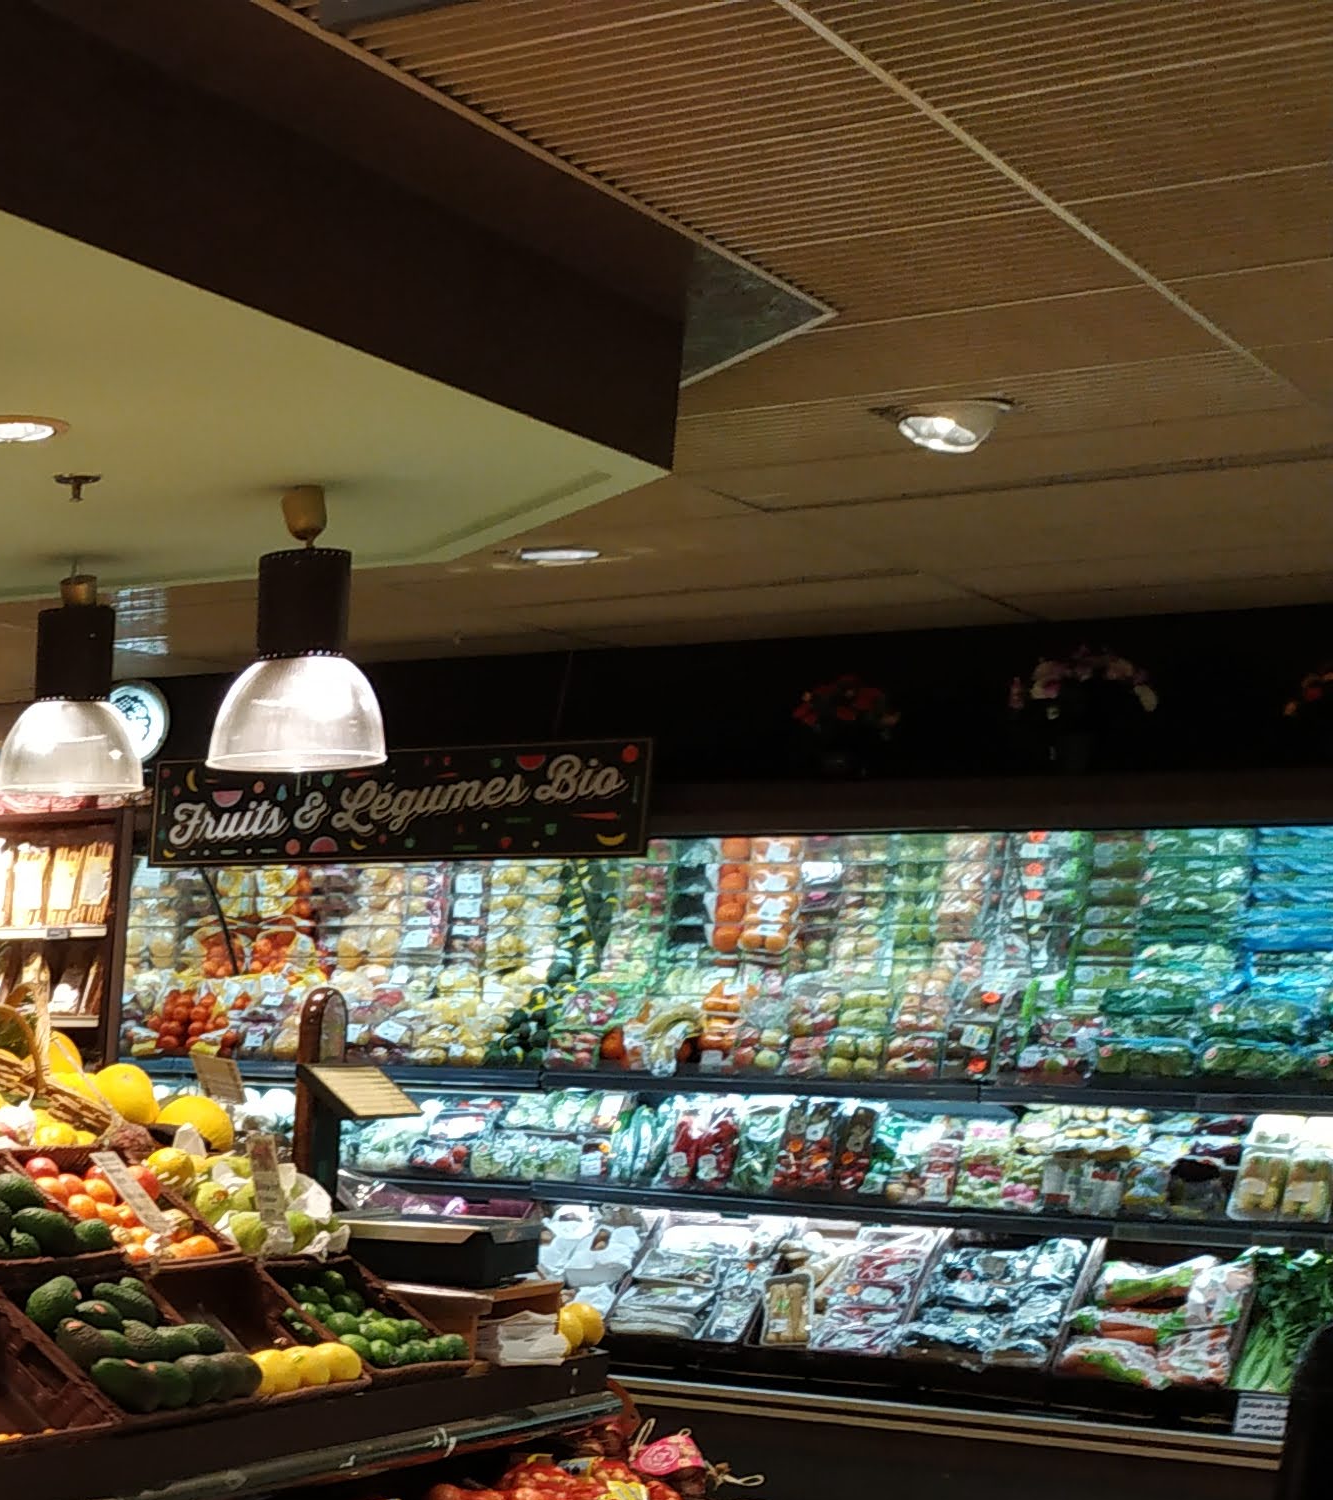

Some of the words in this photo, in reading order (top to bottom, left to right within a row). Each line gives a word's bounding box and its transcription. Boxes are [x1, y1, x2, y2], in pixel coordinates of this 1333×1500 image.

[169, 800, 287, 848] Fruits
[292, 793, 331, 831] &
[332, 773, 530, 834] Légumes
[533, 753, 628, 801] Bio
